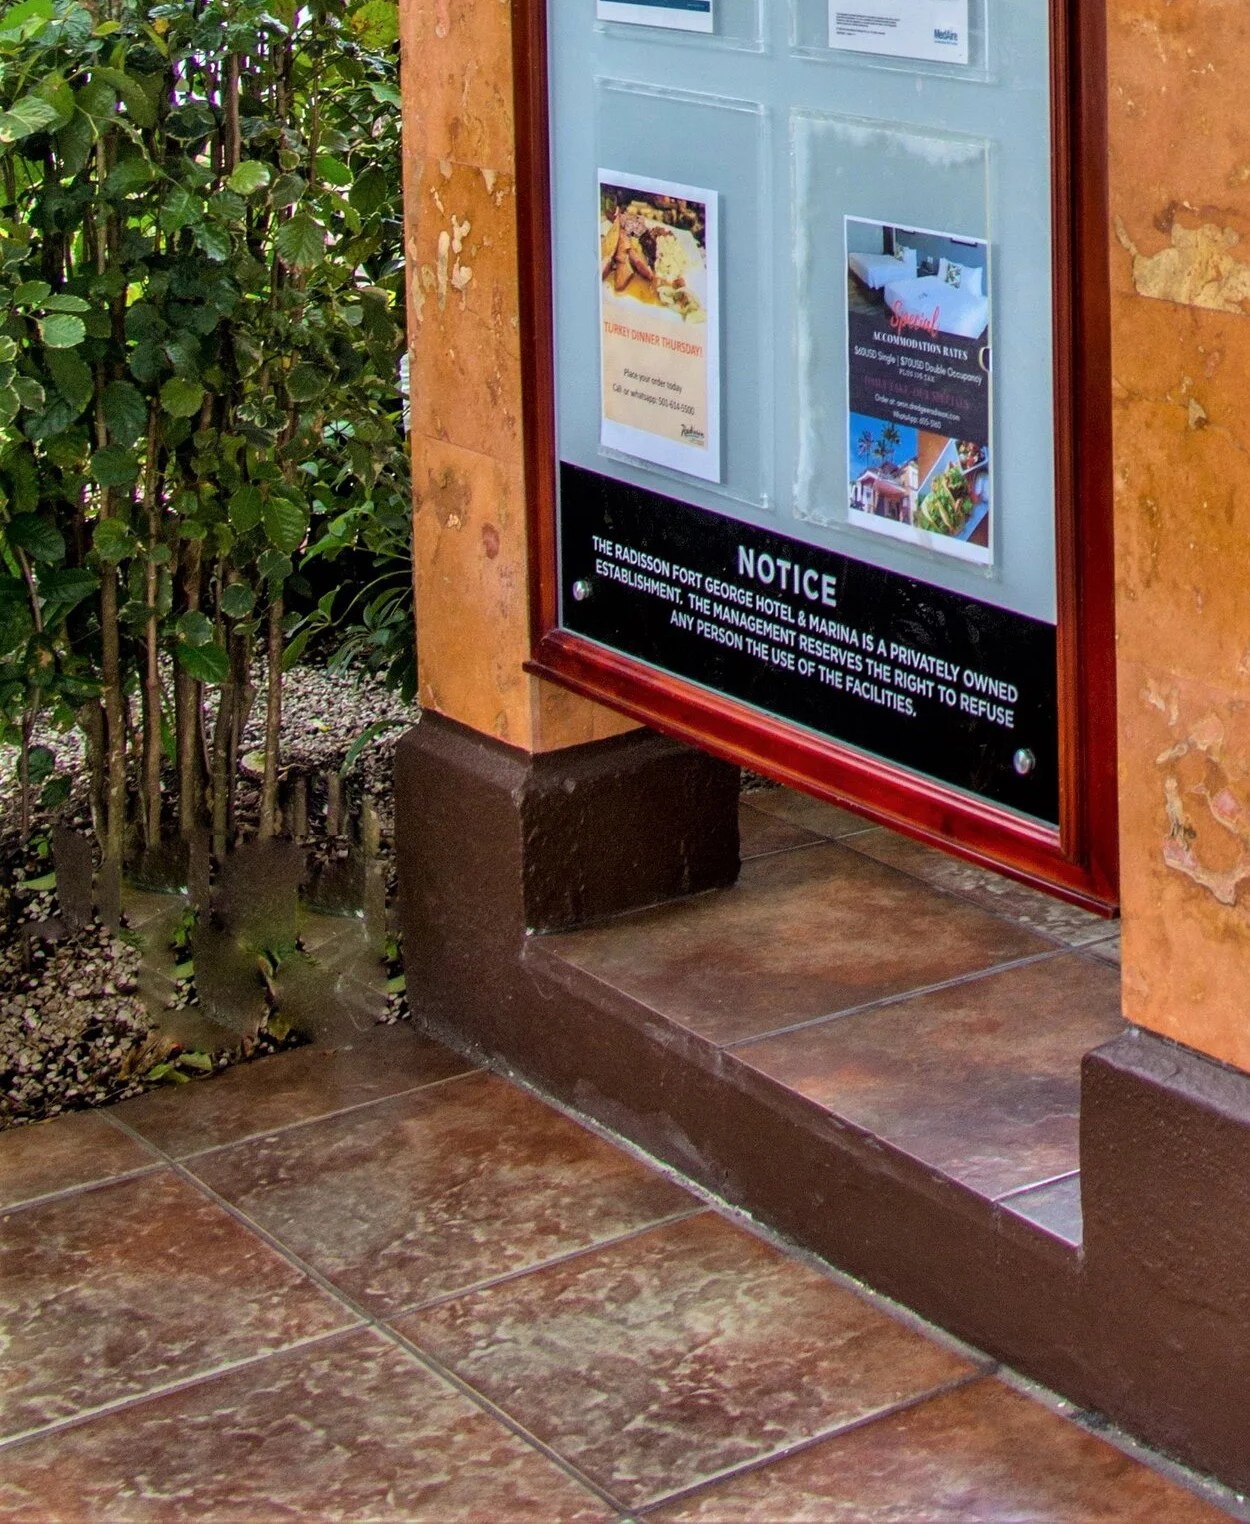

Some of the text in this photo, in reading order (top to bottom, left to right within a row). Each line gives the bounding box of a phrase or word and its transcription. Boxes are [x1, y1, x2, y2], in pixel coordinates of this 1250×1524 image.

[604, 322, 703, 358] TURKEY DINNER THURSDAY!
[890, 300, 940, 340] Special
[854, 346, 877, 358] $60USD
[878, 351, 896, 364] Single
[900, 356, 924, 370] $70USD
[925, 361, 946, 375] Double
[947, 367, 982, 386] Occupancy
[872, 331, 969, 361] ACCOMMODATION RATES
[612, 382, 622, 393] Call
[624, 368, 682, 394] Place your order today
[738, 544, 836, 608] NOTICE
[592, 535, 1018, 704] THE RADISSON FORT GEORGE HOTEL & MARINA IS A PRIVATELY OWNED
[596, 558, 1014, 728] ESTABLISHMENT. THE MANAGEMENT RESERVES THE RIGHT TO REFUSE
[670, 610, 917, 717] ANY PERSON THE USE OF THE FACILITIES.
